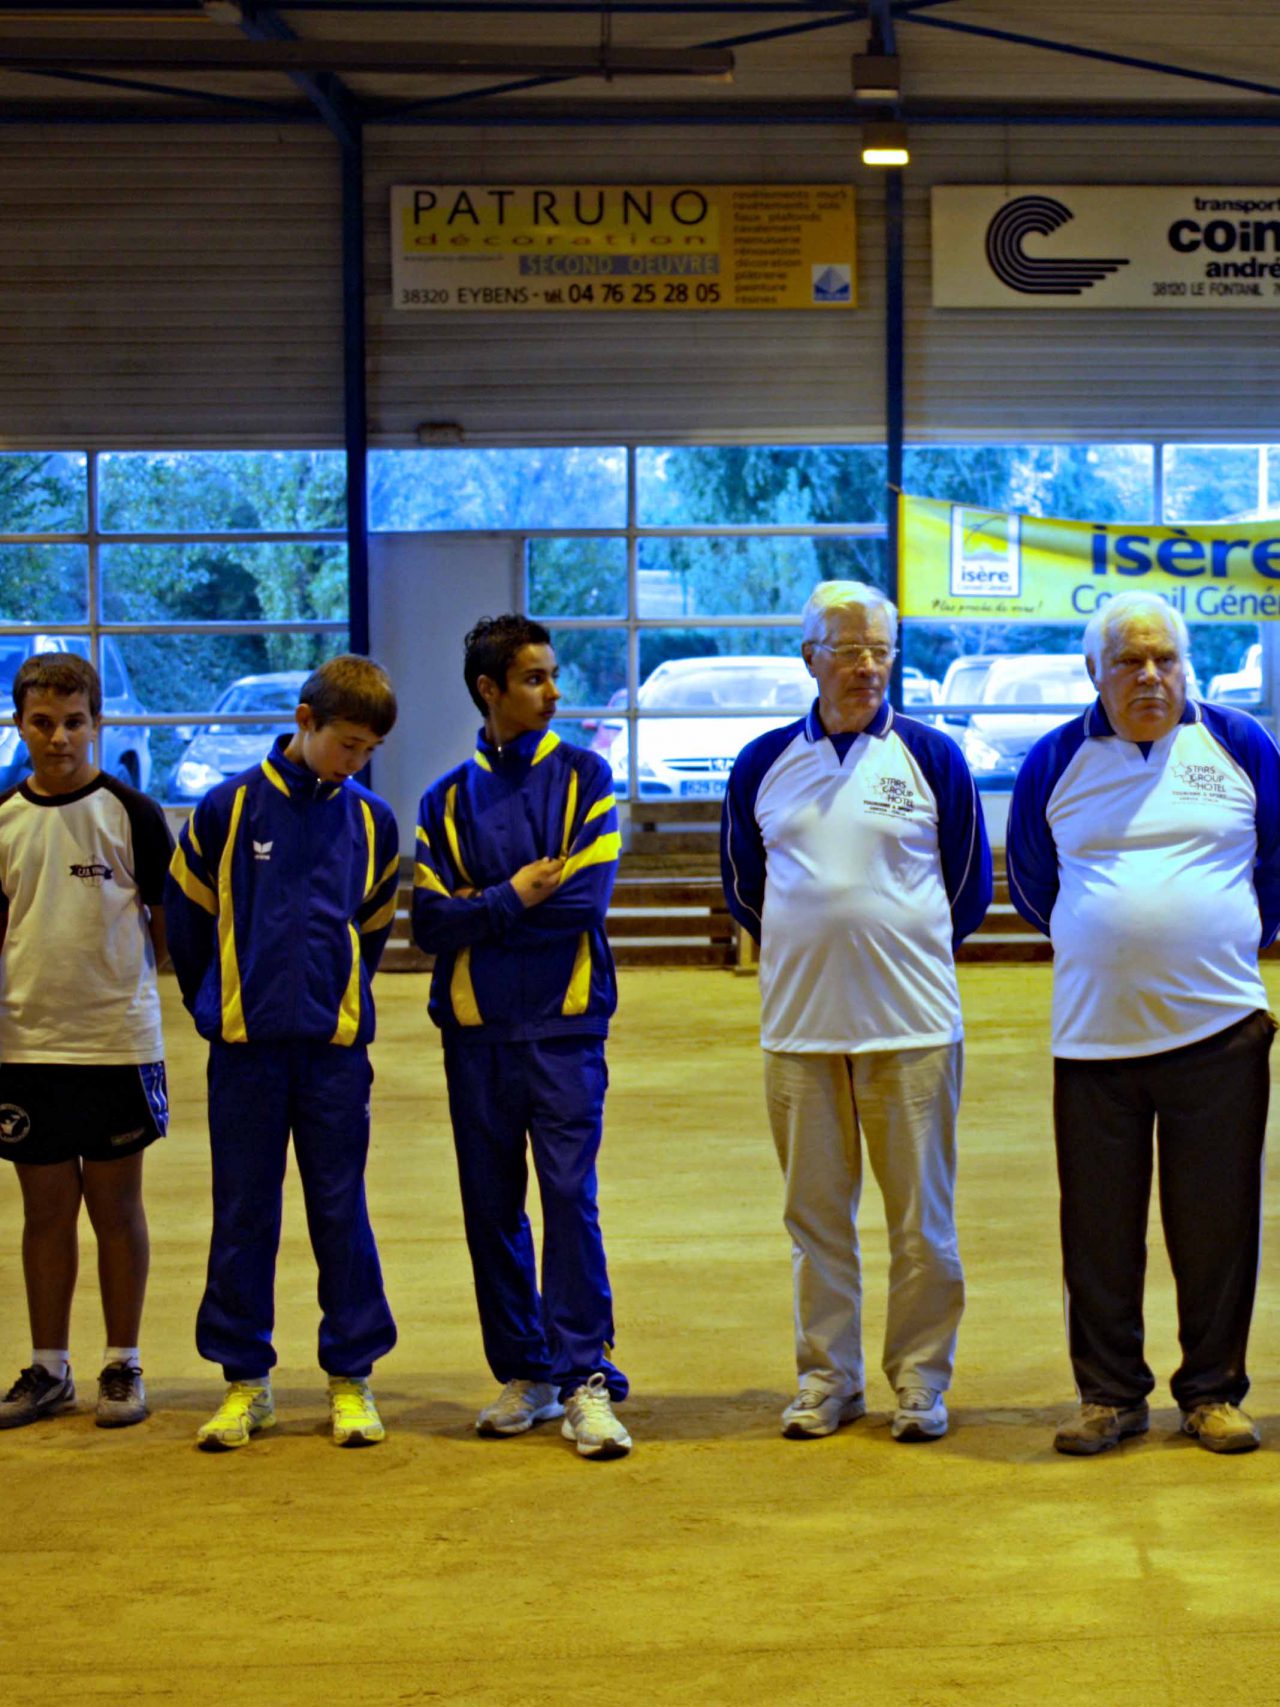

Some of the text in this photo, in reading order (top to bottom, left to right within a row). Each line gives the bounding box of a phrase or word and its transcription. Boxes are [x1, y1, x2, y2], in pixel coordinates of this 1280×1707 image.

[414, 189, 708, 226] PATRUNO
[414, 231, 707, 247] décoration
[527, 255, 716, 275] SECOND OEUVRE
[402, 287, 448, 303] 38320
[458, 286, 528, 304] EYBENS
[568, 284, 594, 303] 04
[603, 285, 623, 303] 76
[632, 285, 656, 303] 25
[664, 285, 688, 302] 28
[695, 284, 720, 302] 05
[1191, 282, 1205, 297] LE
[961, 565, 1009, 583] isère
[1185, 764, 1216, 774] STARS
[880, 777, 906, 788] STARS
[1189, 772, 1225, 783] GROUP
[882, 785, 914, 798] GROUP
[1195, 782, 1226, 793] HOTEL
[887, 794, 913, 808] HOTEL
